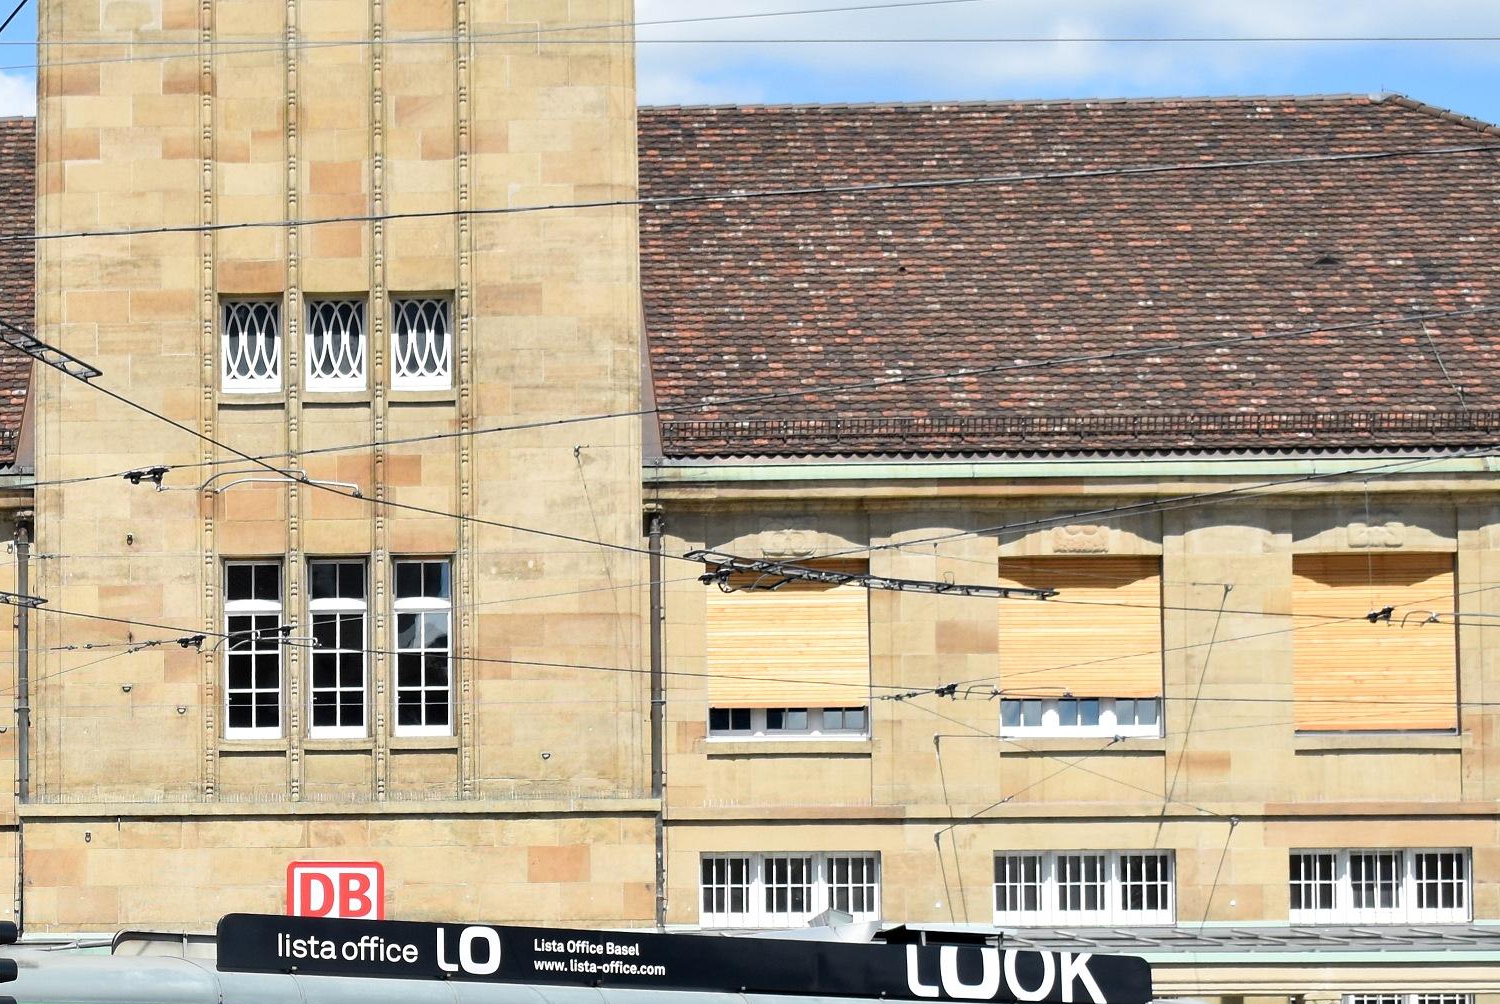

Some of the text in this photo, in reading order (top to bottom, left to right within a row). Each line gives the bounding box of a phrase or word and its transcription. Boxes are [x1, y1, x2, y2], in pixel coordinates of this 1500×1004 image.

[300, 872, 373, 918] DB
[277, 926, 501, 975] lista office LO
[534, 939, 640, 956] Lista Office Basel
[570, 959, 666, 976] lista-office.com
